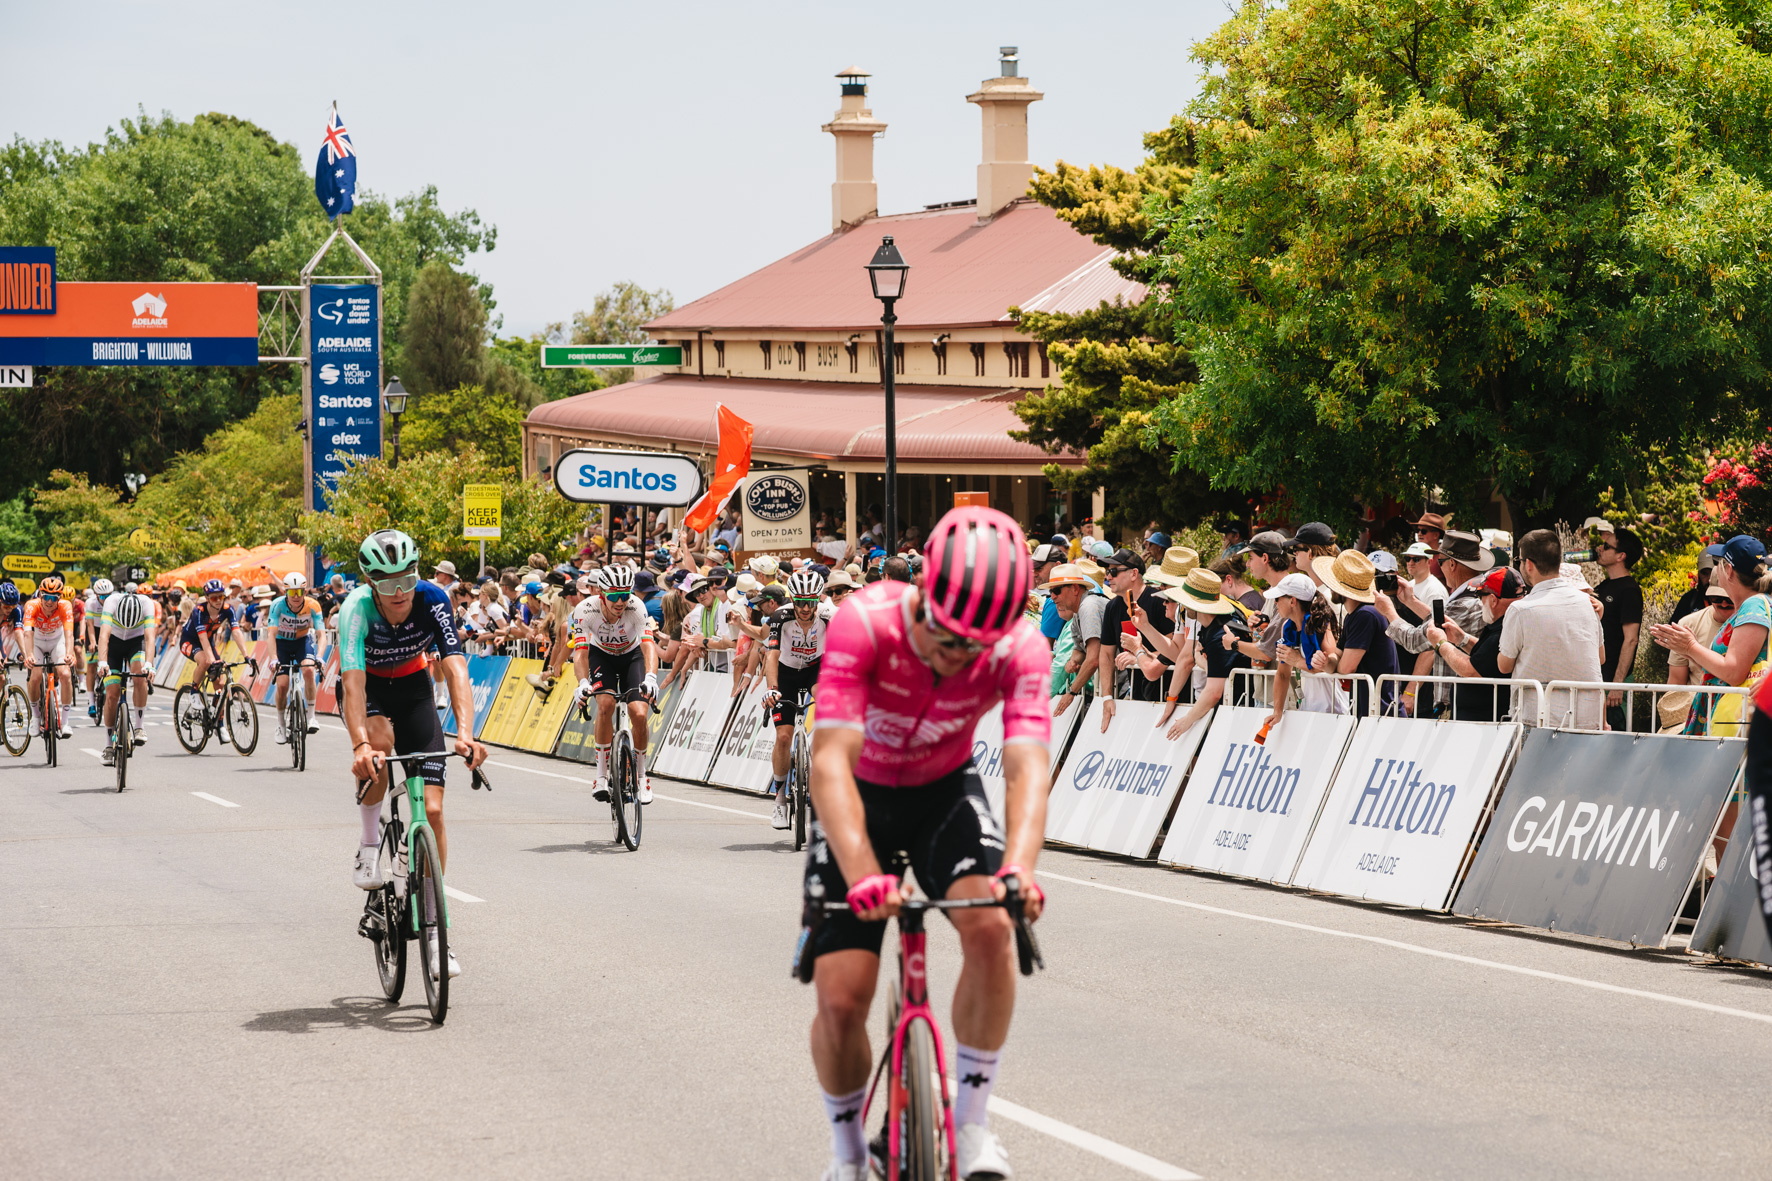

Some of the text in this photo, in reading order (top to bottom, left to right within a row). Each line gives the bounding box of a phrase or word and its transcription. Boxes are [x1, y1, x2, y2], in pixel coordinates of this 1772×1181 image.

[317, 337, 372, 348] ADELAIDE
[92, 342, 139, 361] BRIGHTON
[146, 342, 192, 361] WILLUNGA
[777, 344, 878, 368] OLD BUSH IN
[343, 363, 360, 371] UCI
[343, 370, 372, 378] WORLD
[343, 377, 365, 385] TOUR
[318, 394, 373, 408] Santos
[331, 431, 361, 445] efex
[324, 453, 367, 461] GAIN
[577, 463, 677, 492] Santos
[751, 479, 801, 499] OLD BUSH
[765, 489, 786, 498] INN
[468, 507, 498, 517] KEEP
[761, 509, 793, 519] WILLUNGA
[467, 517, 498, 526] CLEAR
[751, 529, 772, 537] OPEN
[781, 527, 803, 536] DAYS
[769, 550, 802, 558] CLASSICS
[404, 622, 415, 631] VR
[429, 602, 458, 646] Adecco
[373, 634, 432, 656] DECATHLON
[600, 635, 628, 643] UAE
[791, 640, 818, 648] UAE
[668, 697, 704, 750] efex
[725, 704, 763, 759] efex
[1098, 757, 1172, 797] HYUNDAI
[1207, 743, 1301, 816] Hilton
[1349, 758, 1456, 836] Hilton
[1213, 830, 1252, 850] ADELAIDE
[1507, 795, 1680, 871] GARMIN
[1356, 852, 1401, 876] ADELAIDE
